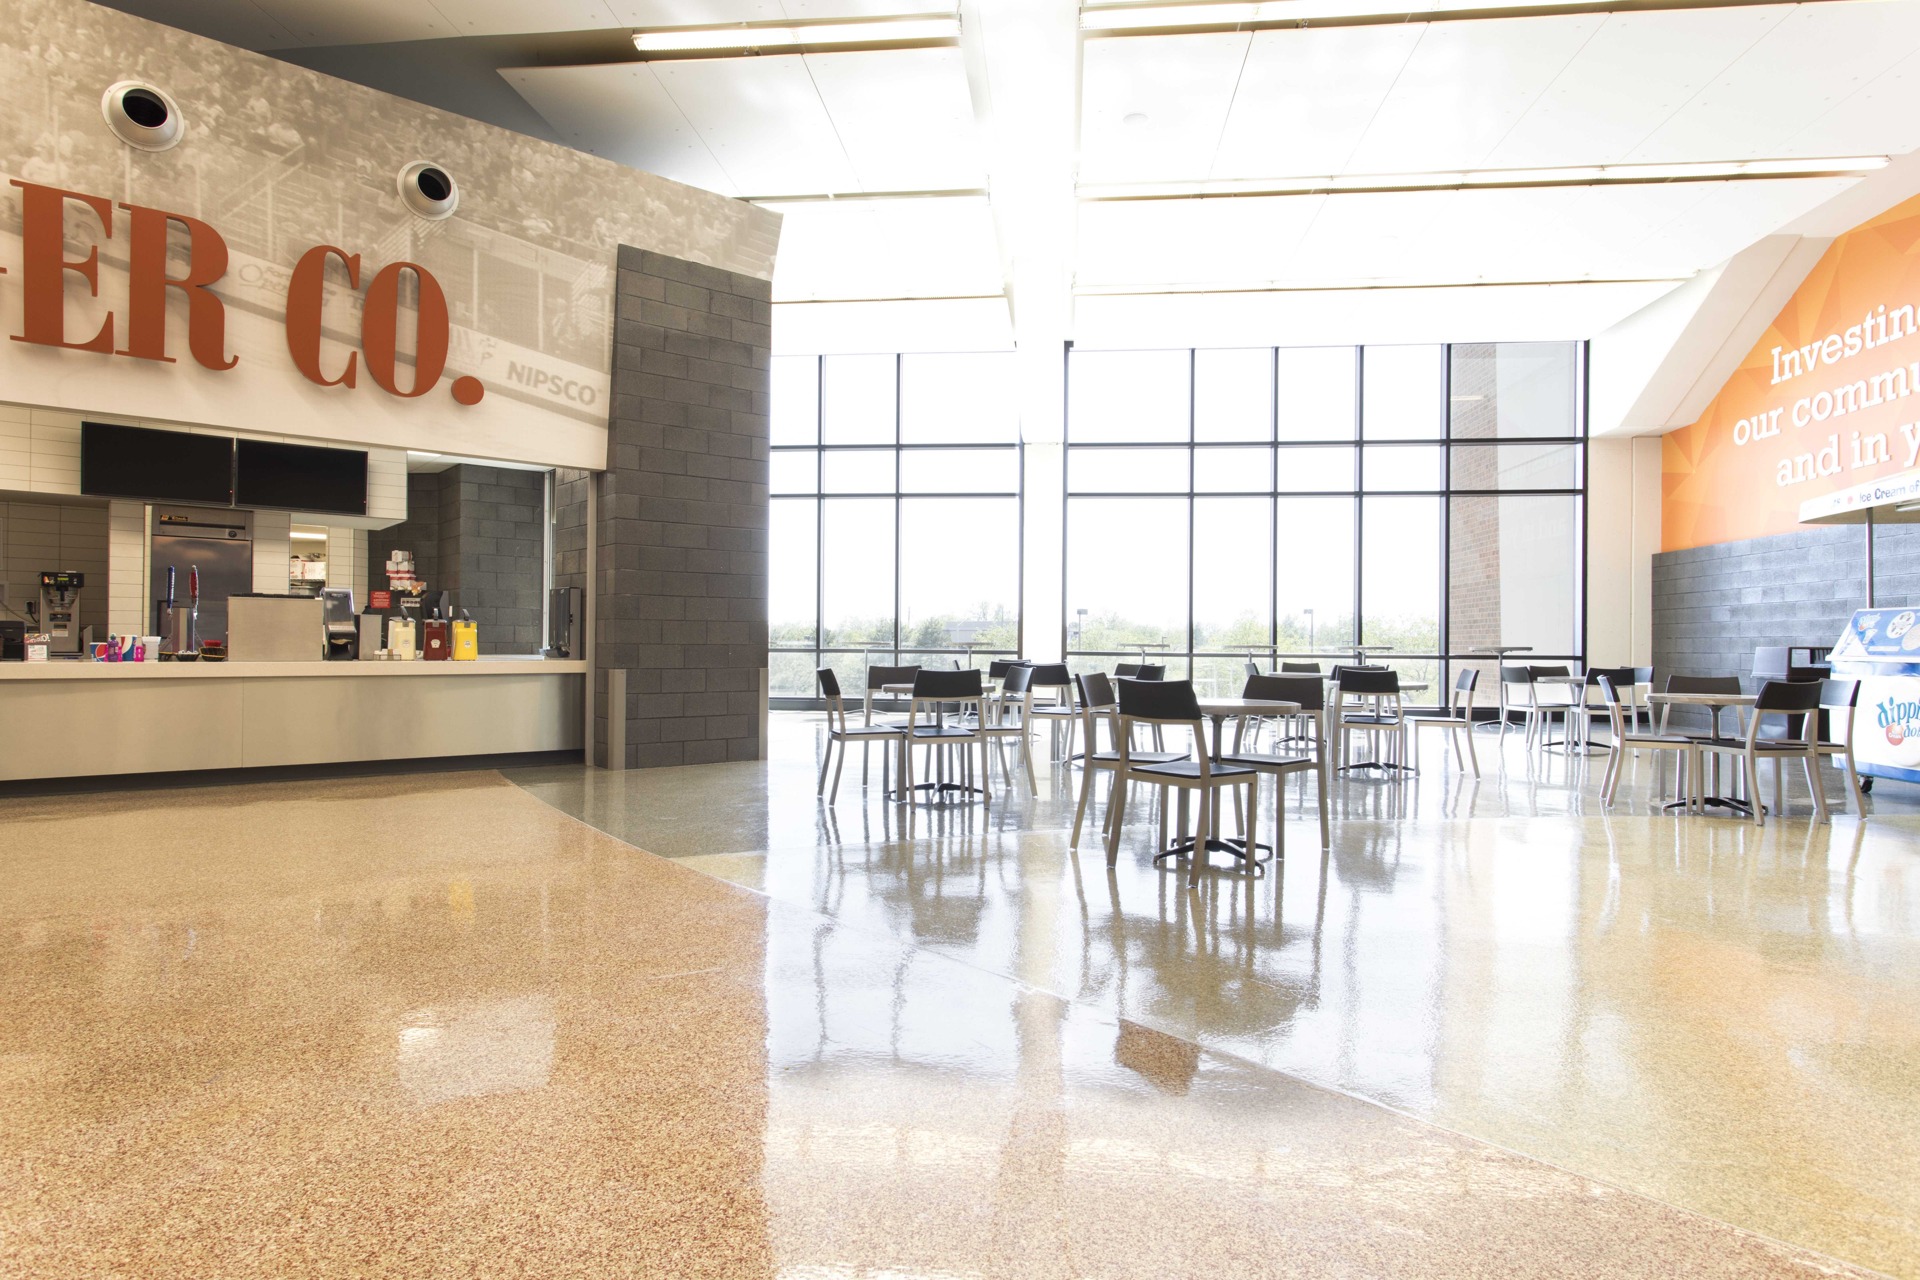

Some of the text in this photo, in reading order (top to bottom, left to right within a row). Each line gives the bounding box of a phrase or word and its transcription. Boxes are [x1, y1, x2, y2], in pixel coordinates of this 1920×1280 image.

[0, 178, 485, 406] ER CO.
[1771, 303, 1920, 384] Investin
[506, 360, 597, 406] NIPSCO
[1733, 406, 1784, 446] our
[1776, 433, 1843, 487] and
[1851, 431, 1892, 469] in
[1859, 492, 1872, 503] Ice
[1874, 486, 1906, 500] Cream
